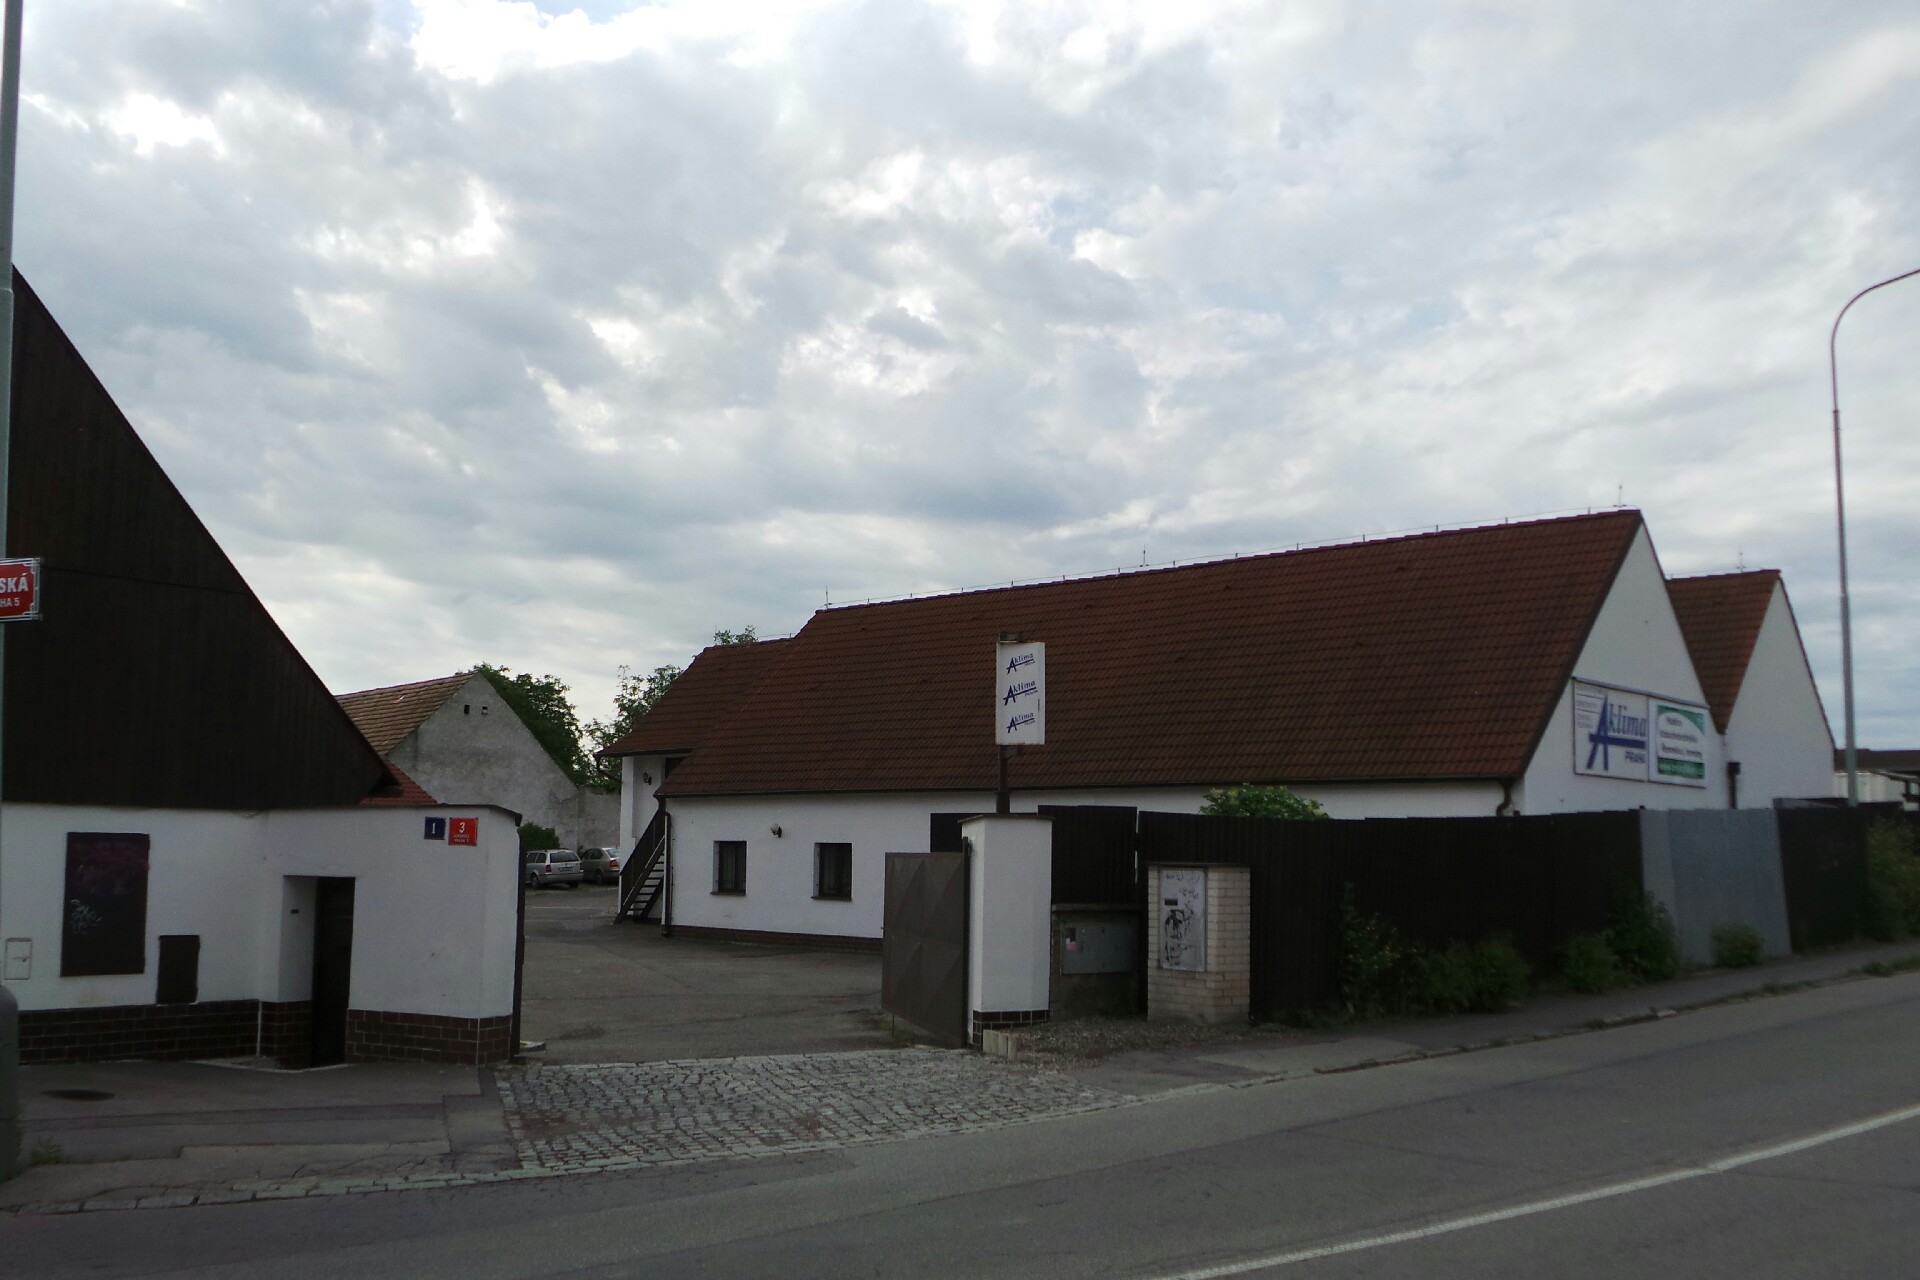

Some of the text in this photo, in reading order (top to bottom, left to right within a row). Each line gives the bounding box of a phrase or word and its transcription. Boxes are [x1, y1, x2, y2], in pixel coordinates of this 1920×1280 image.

[14, 597, 20, 607] 5
[1006, 653, 1034, 675] Aklima
[1003, 680, 1037, 706] Aklima
[1006, 712, 1034, 734] Aklima
[1586, 694, 1646, 771] Aklima
[431, 822, 436, 834] 1
[459, 821, 466, 833] 3
